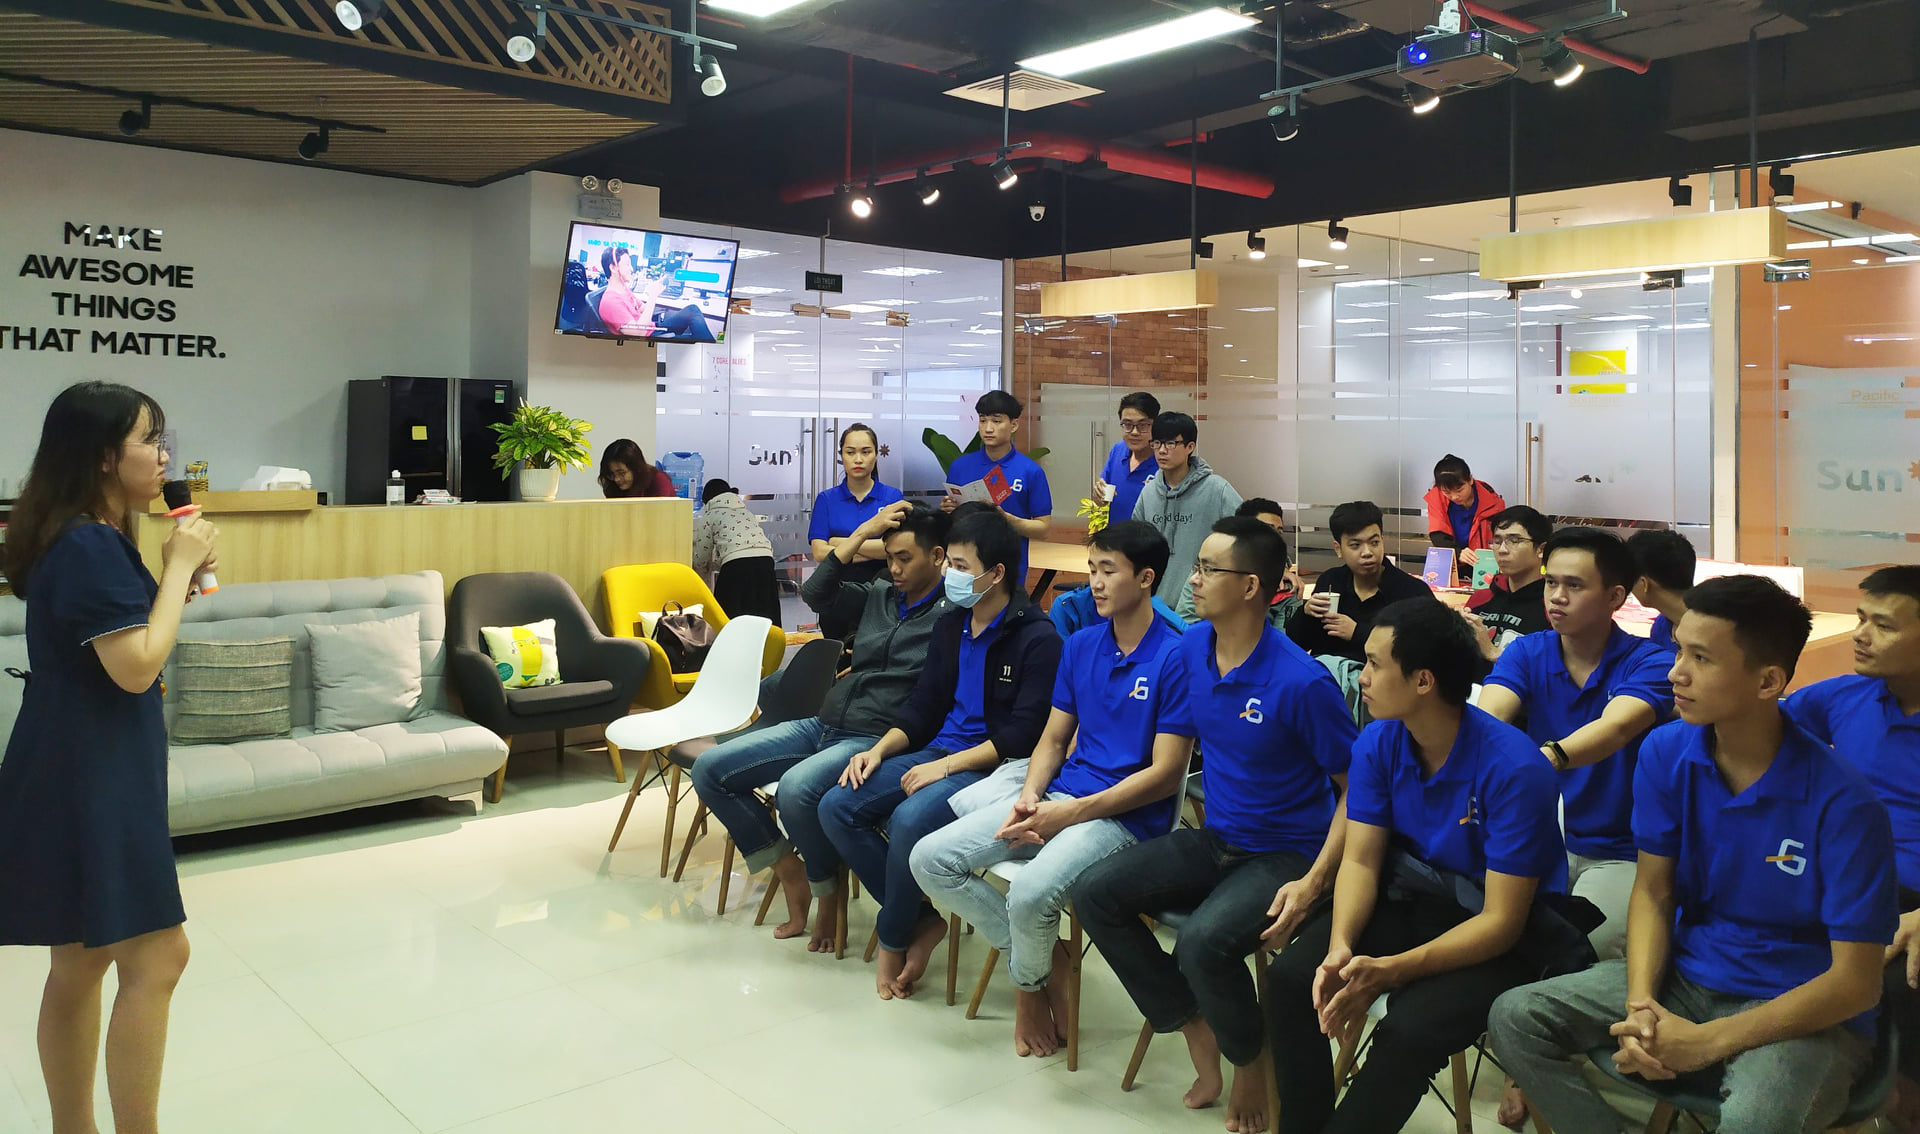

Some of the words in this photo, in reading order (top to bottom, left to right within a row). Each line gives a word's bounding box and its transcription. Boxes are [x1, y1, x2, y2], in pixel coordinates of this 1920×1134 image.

[64, 221, 163, 252] MAKE
[19, 254, 194, 289] AWESOME
[51, 291, 176, 323] THINGS
[0, 325, 81, 352] THAT
[91, 330, 227, 359] MATTER.
[1850, 389, 1899, 401] Pacific
[1173, 512, 1193, 525] day!
